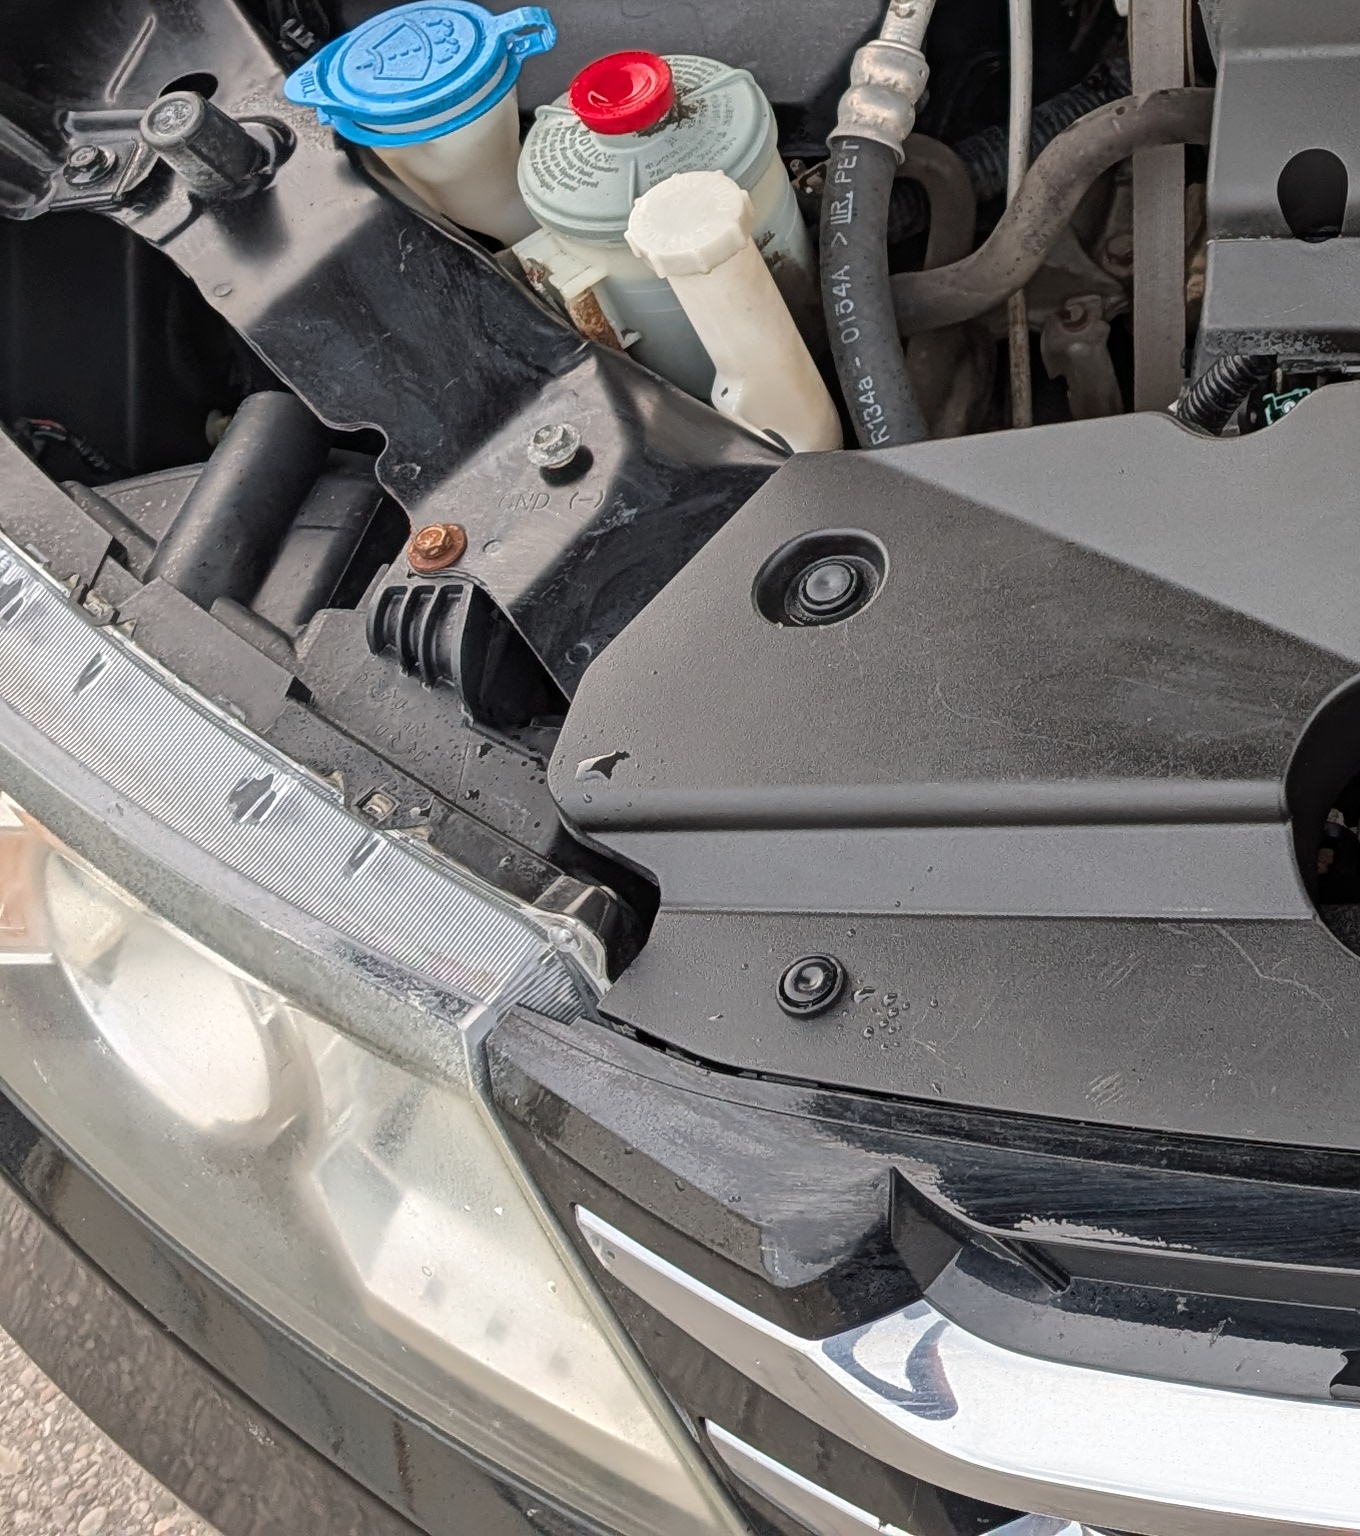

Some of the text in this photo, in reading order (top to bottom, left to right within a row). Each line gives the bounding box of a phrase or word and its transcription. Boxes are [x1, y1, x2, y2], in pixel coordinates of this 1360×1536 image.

[297, 70, 317, 99] PULL
[831, 264, 860, 345] 0154A
[859, 374, 891, 446] R134a
[498, 492, 551, 512] GND
